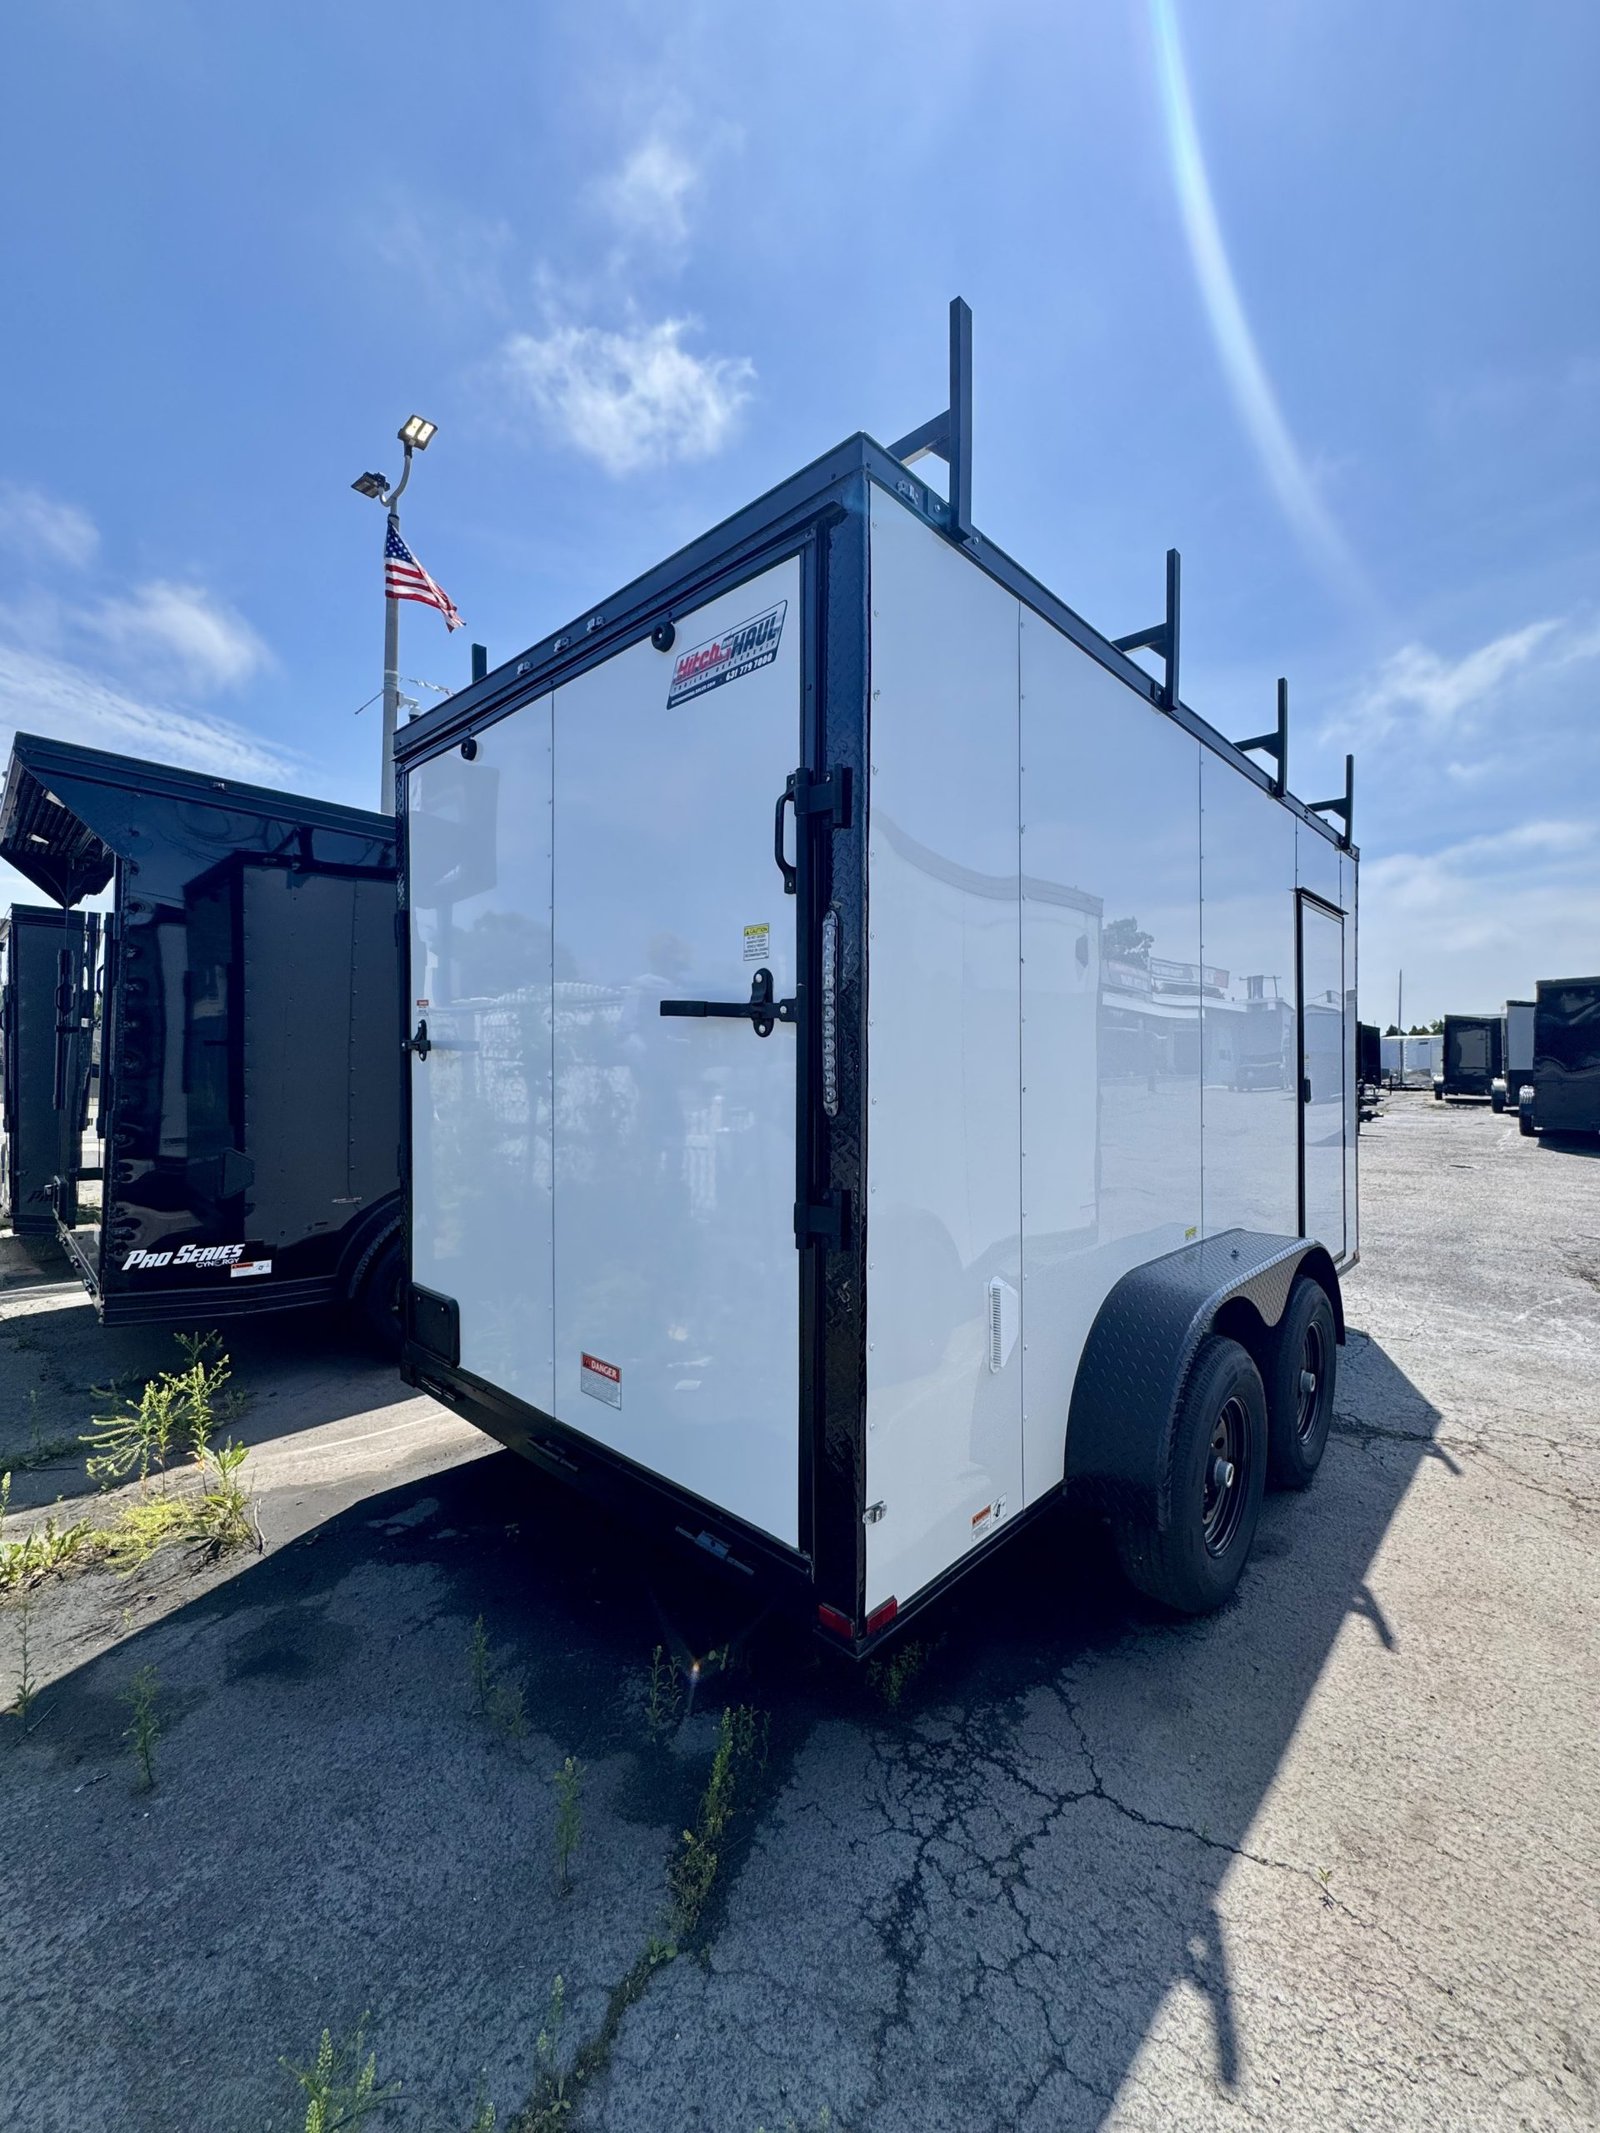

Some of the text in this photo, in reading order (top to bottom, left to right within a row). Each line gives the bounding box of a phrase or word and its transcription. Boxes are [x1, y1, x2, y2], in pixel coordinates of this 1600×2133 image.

[677, 615, 780, 679] Hitch HAUL
[725, 668, 738, 681] 631
[122, 1243, 246, 1271] PRO SERIES
[591, 1360, 618, 1379] DANGER
